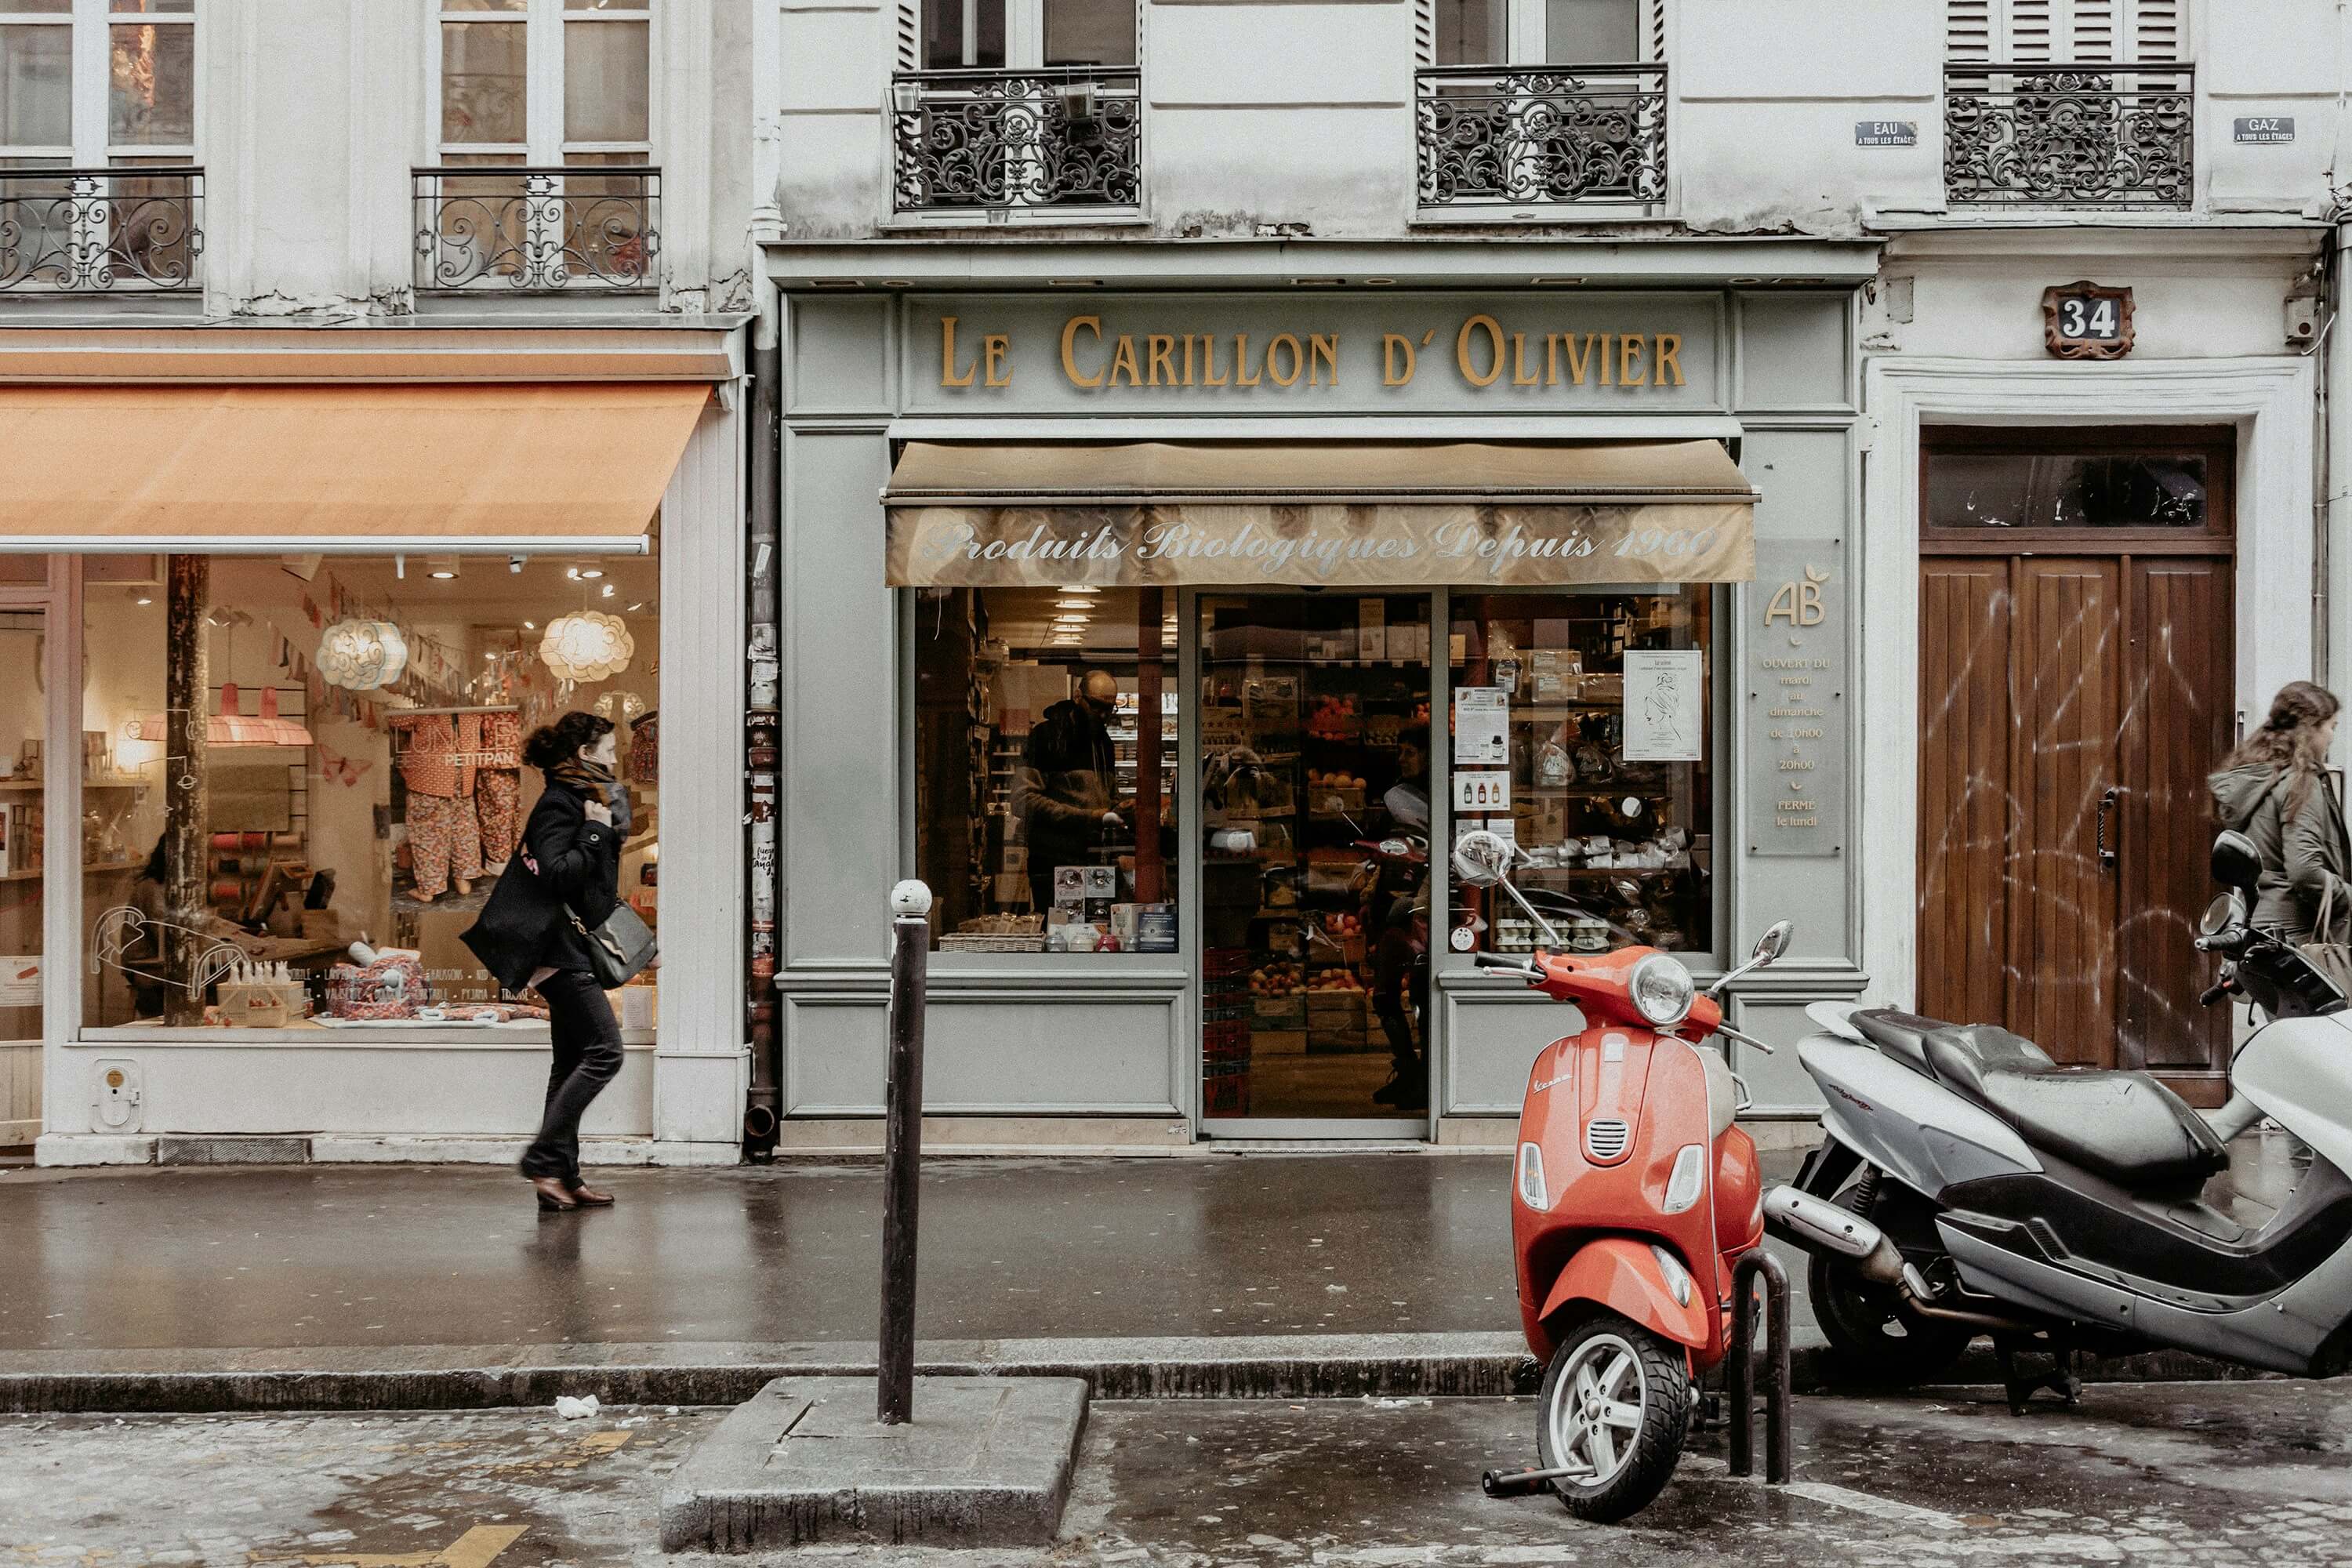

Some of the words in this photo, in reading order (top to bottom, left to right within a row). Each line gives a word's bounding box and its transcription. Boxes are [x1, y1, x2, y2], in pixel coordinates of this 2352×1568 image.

[1874, 122, 1898, 135] EAU
[2249, 118, 2279, 131] GAZ
[2271, 132, 2293, 140] ÉTAGES
[2062, 299, 2115, 338] 34
[940, 316, 1013, 387] LE
[1061, 315, 1340, 388] CARILLON
[1457, 314, 1686, 387] OLIVIER
[924, 521, 1131, 561] Produits
[1136, 521, 1423, 575] Biologiques
[1433, 520, 1606, 575] Depuis
[1765, 581, 1825, 626] AB
[1762, 658, 1808, 669] OUVERT
[1813, 658, 1832, 669] DU
[1780, 675, 1813, 684] mardi
[1769, 707, 1825, 717] dimanche
[1770, 728, 1783, 738] de
[445, 752, 514, 767] PETITPAN
[1780, 759, 1815, 770] 20h00
[1777, 815, 1788, 826] le
[1790, 815, 1817, 826] lundi
[461, 988, 488, 1000] PYJAMA
